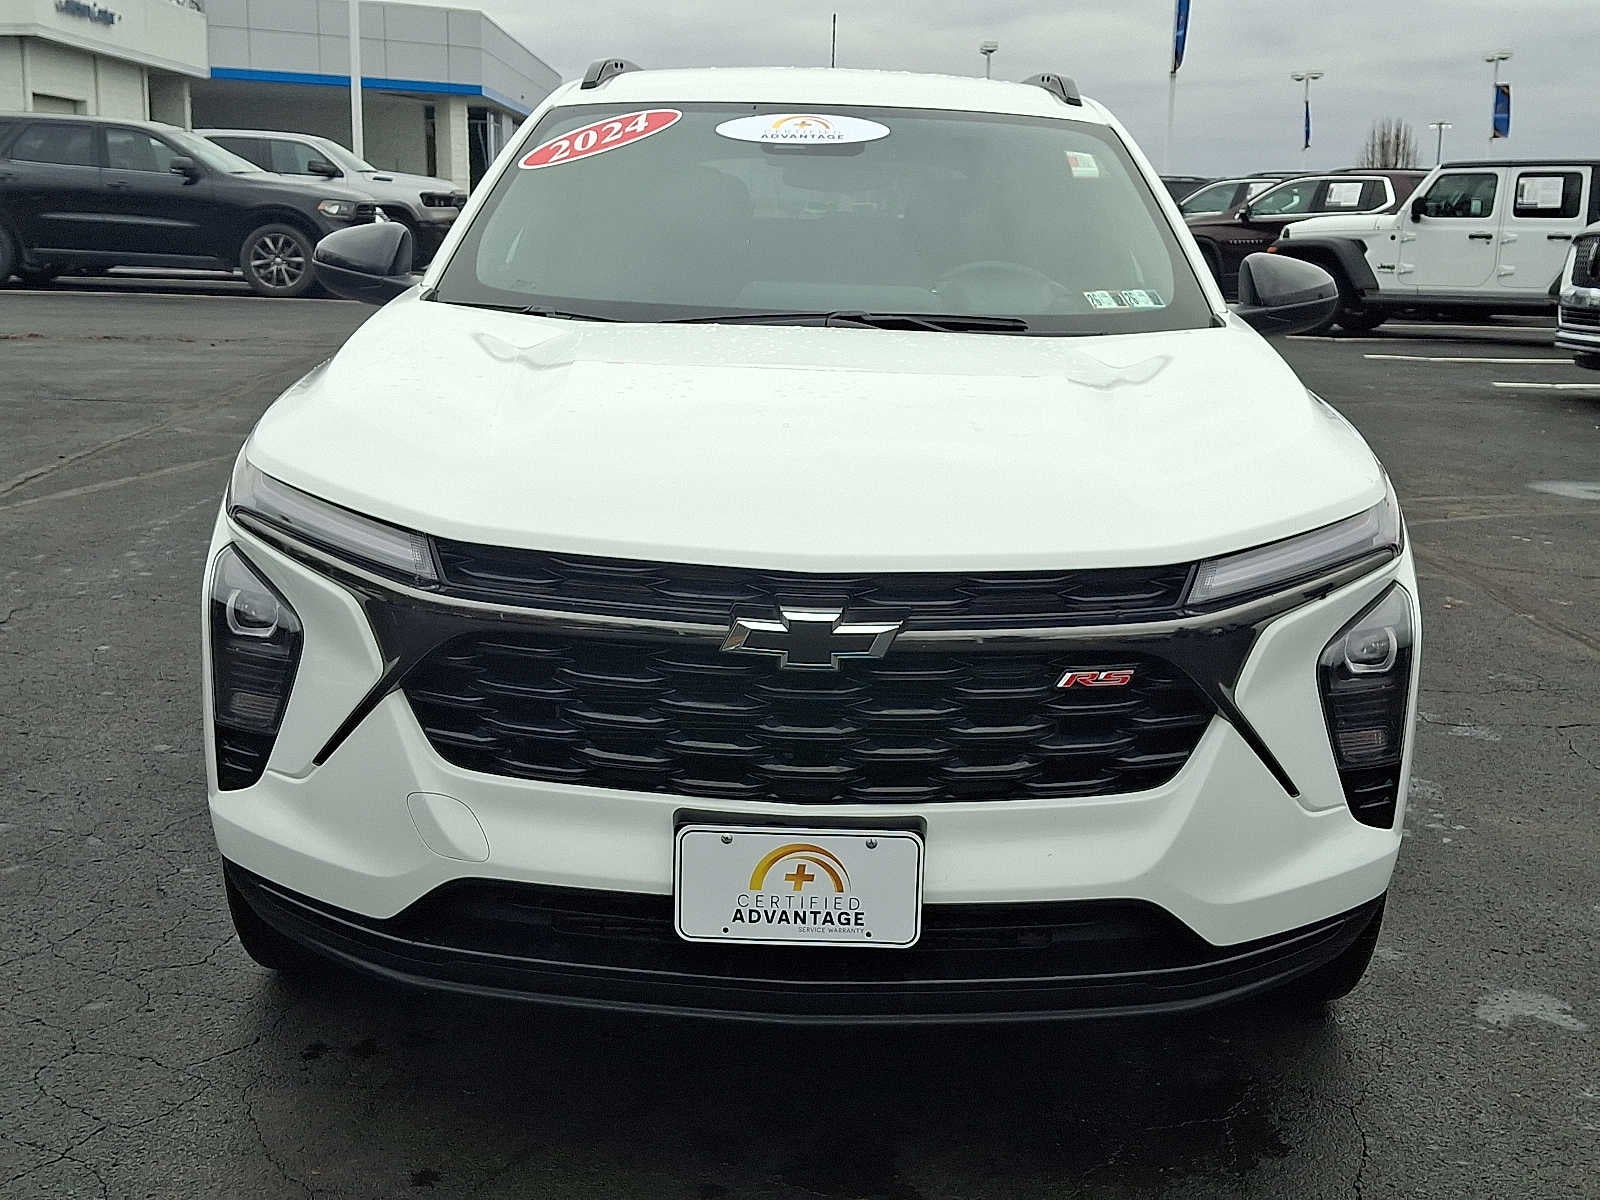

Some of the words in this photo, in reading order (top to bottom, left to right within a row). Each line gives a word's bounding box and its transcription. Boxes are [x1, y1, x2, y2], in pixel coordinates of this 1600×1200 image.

[548, 111, 649, 163] 2024
[1056, 669, 1135, 688] RS
[737, 894, 861, 911] CERTIFIED
[731, 908, 865, 927] ADVANTAGE
[799, 926, 825, 934] SERVICE
[827, 927, 865, 935] WARRANTY
